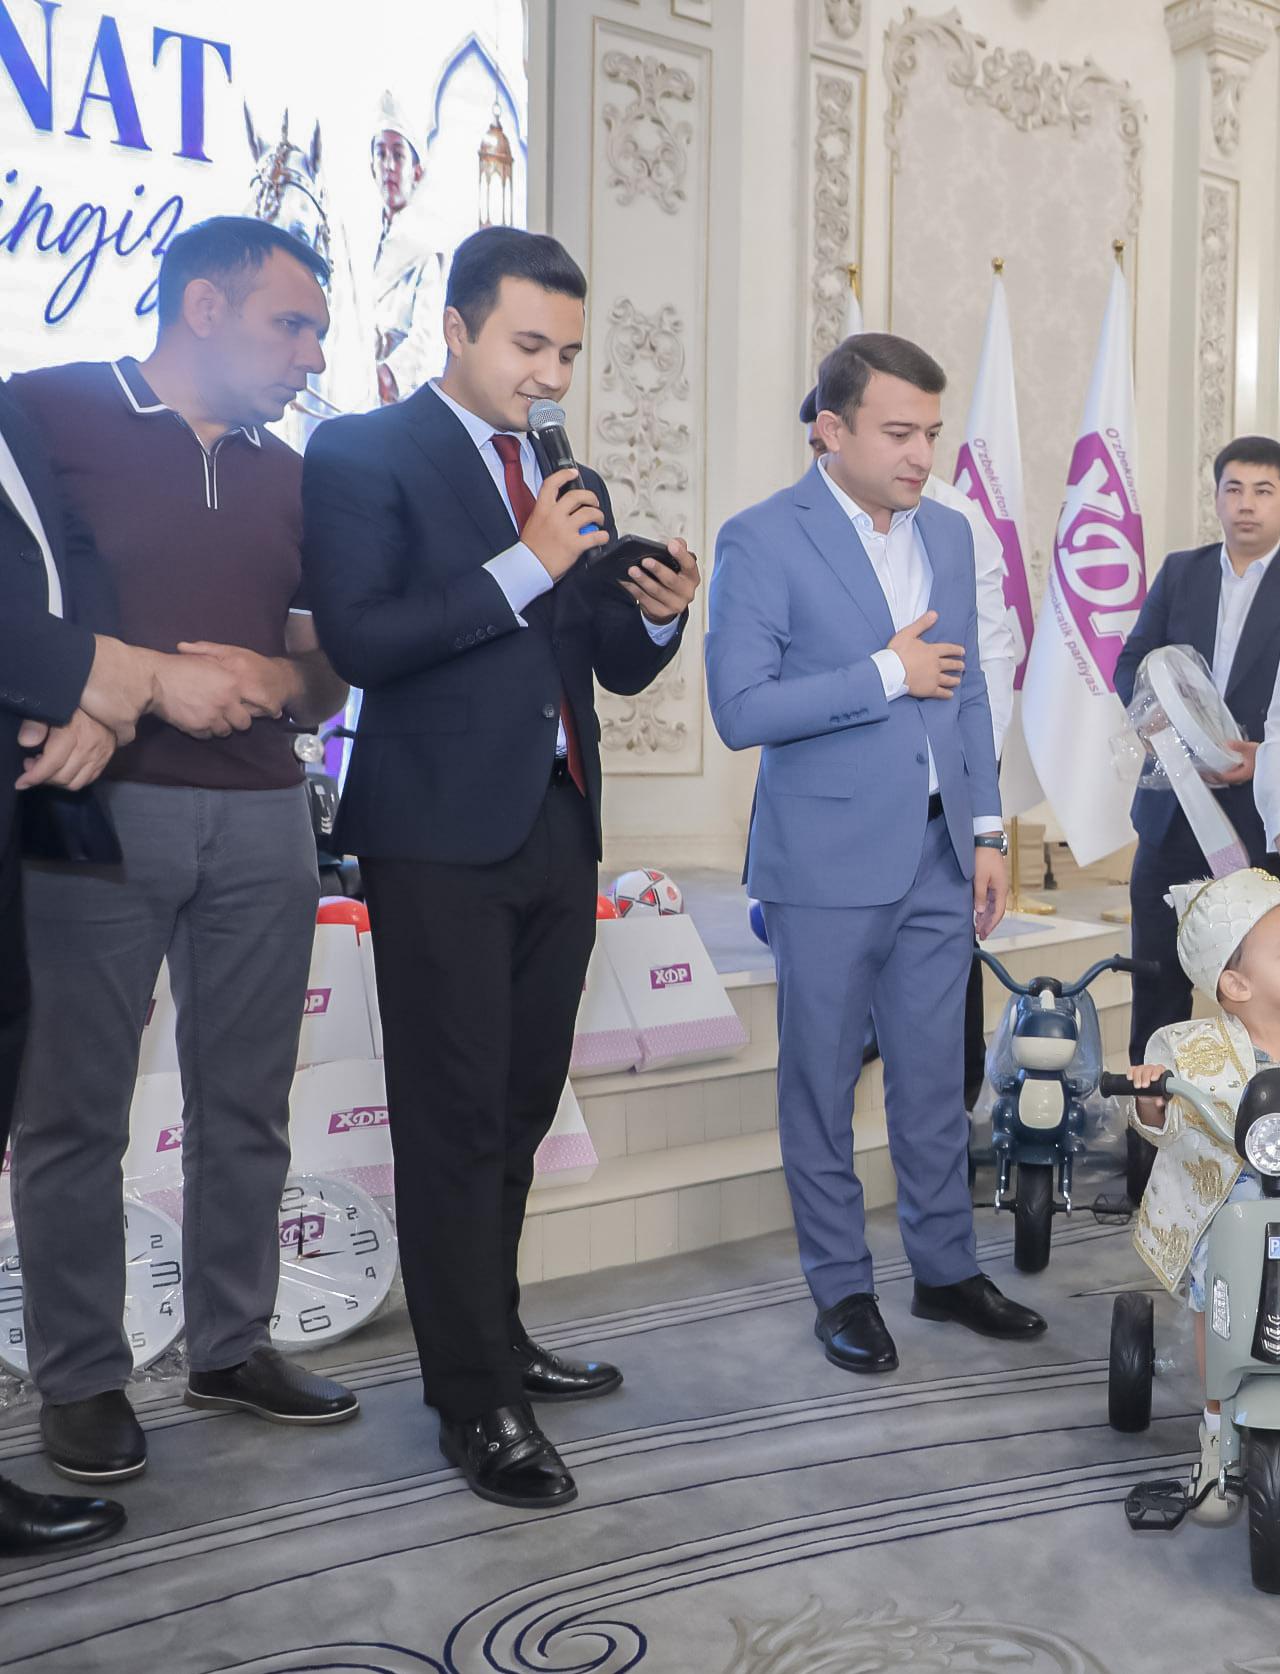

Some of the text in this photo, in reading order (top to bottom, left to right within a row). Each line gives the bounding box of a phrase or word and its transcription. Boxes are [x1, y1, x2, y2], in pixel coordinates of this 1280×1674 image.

[0, 0, 232, 163] NAT
[0, 169, 183, 324] ngiz
[346, 1207, 358, 1220] 2
[150, 1234, 163, 1248] 2
[350, 1229, 380, 1255] 3
[1270, 1240, 1280, 1252] P
[150, 1261, 182, 1288] 3
[365, 1266, 377, 1279] 4
[159, 1301, 173, 1316] 4
[345, 1295, 359, 1310] 5
[299, 1305, 332, 1333] 6
[131, 1331, 146, 1348] 5
